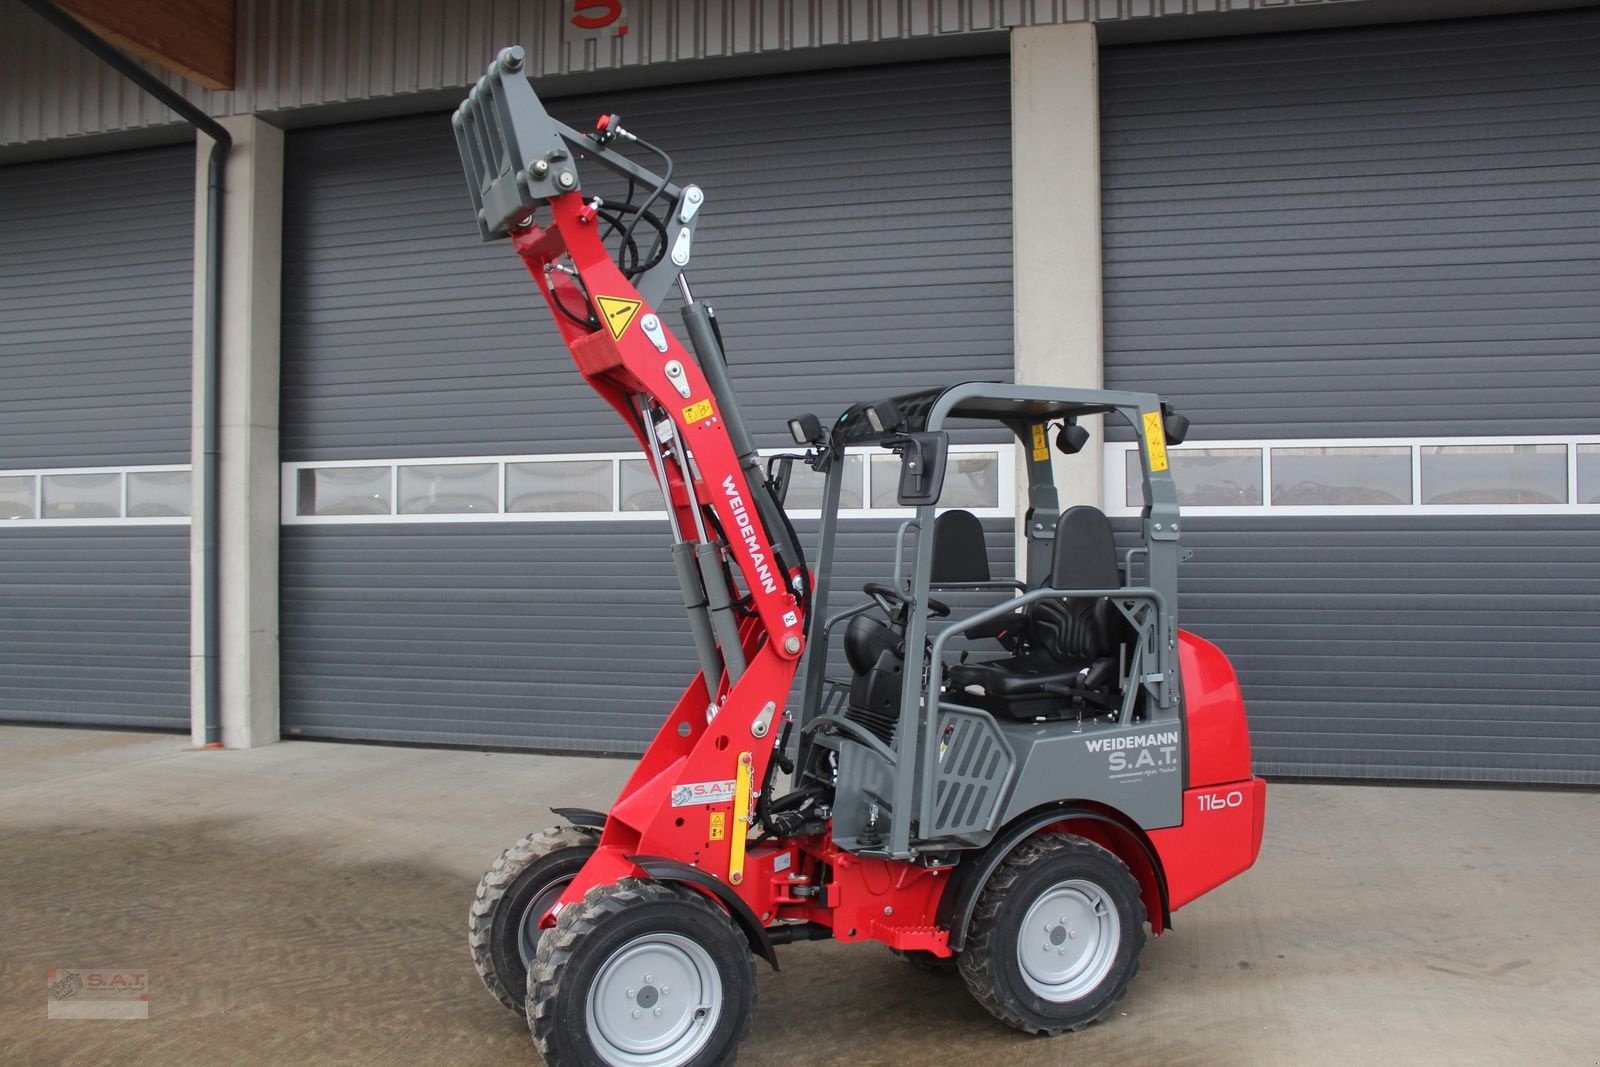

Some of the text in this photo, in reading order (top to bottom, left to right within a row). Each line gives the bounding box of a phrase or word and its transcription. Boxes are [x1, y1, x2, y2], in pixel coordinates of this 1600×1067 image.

[722, 474, 777, 594] WEIDEMANN
[1086, 731, 1178, 753] WEIDEMANN
[1108, 746, 1177, 771] S.A.T.
[1198, 791, 1243, 812] 1160
